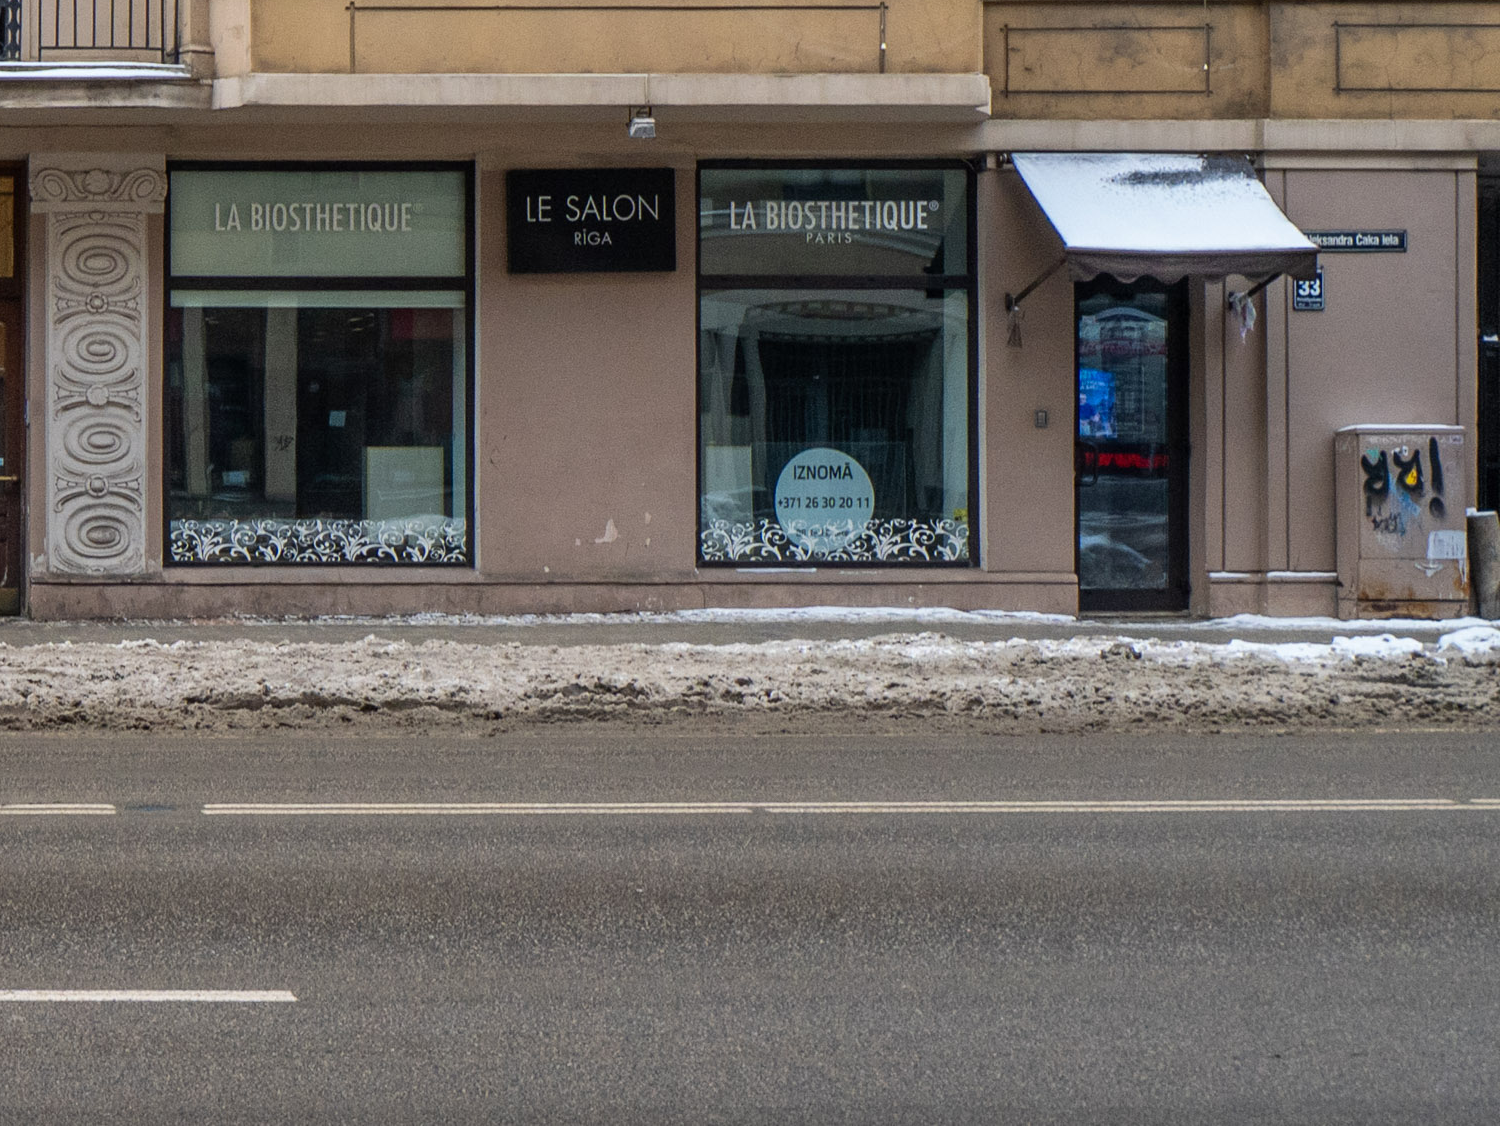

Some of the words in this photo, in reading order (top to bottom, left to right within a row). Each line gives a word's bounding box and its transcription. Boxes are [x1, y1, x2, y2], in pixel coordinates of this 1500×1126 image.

[215, 203, 241, 231] LA
[526, 195, 552, 222] LE
[565, 194, 659, 222] SALON
[730, 201, 757, 230] LA
[806, 232, 852, 244] PARIS
[1307, 234, 1353, 246] leksandra
[1298, 278, 1321, 297] 33
[793, 462, 854, 480] IZNOMĀ
[778, 497, 801, 509] +371
[805, 497, 819, 509] 26
[822, 497, 836, 509] 30
[839, 497, 853, 509] 20
[856, 497, 870, 509] 11
